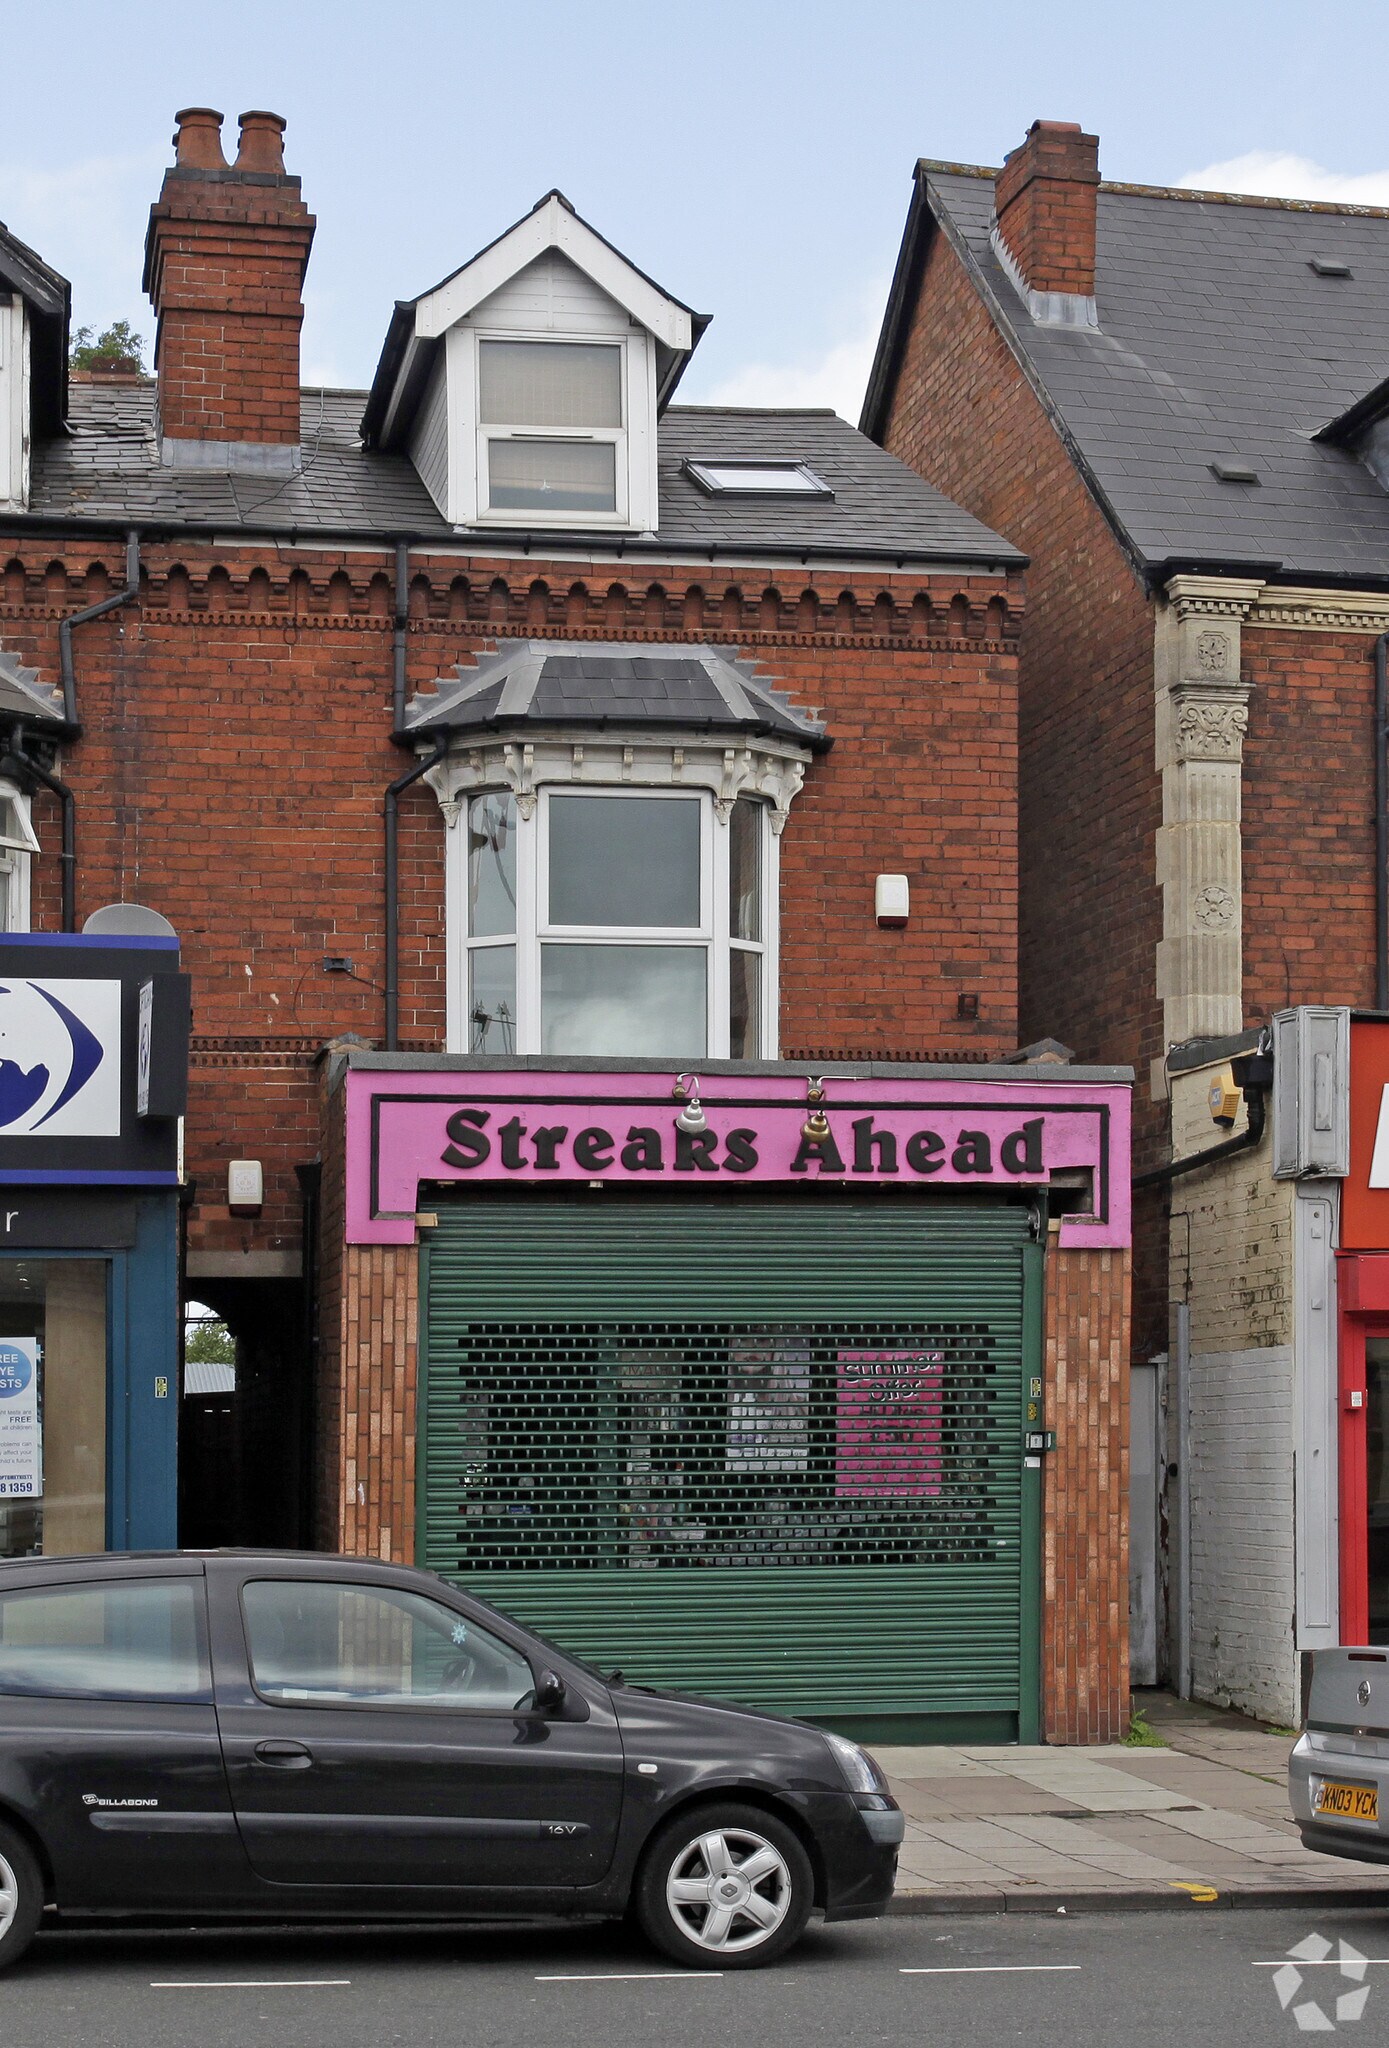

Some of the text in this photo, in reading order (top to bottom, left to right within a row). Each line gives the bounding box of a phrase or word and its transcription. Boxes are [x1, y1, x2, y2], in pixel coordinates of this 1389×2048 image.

[440, 1108, 1045, 1174] Streaks Ahead
[9, 1482, 33, 1492] 1359
[1322, 1787, 1377, 1816] KN03 YCK
[548, 1825, 577, 1834] 16V
